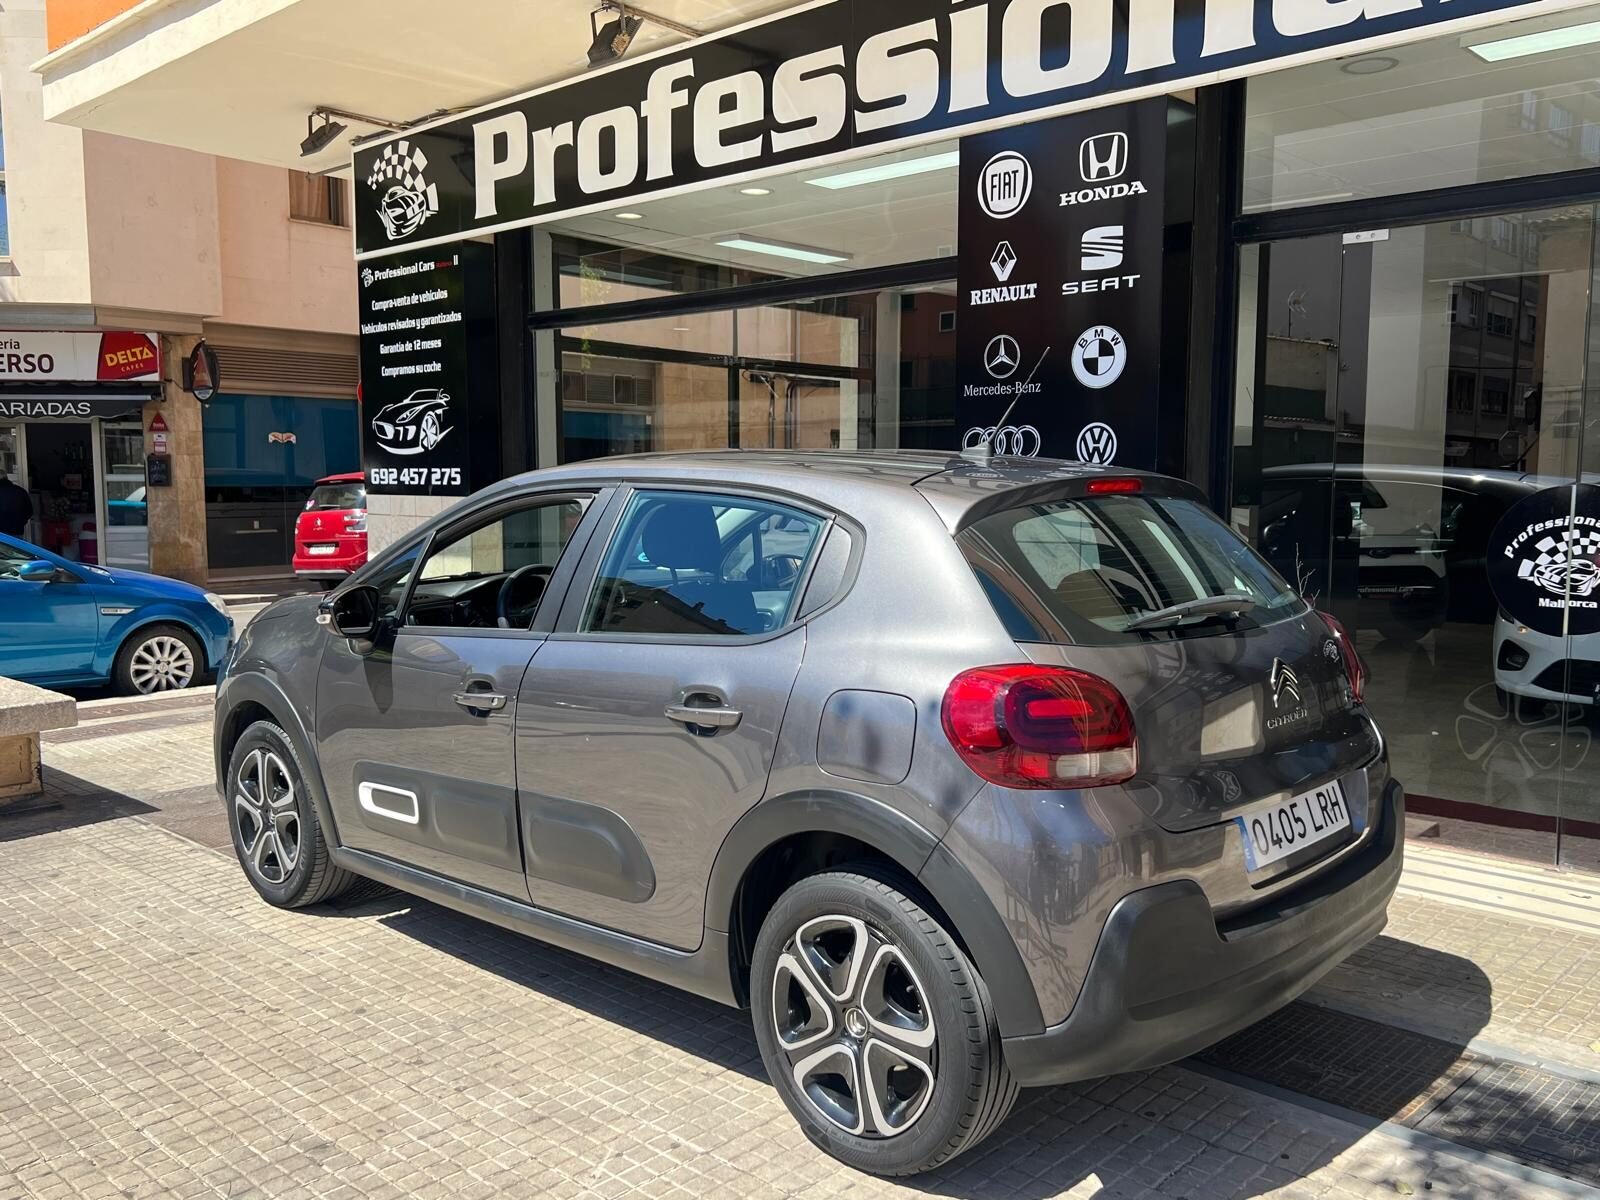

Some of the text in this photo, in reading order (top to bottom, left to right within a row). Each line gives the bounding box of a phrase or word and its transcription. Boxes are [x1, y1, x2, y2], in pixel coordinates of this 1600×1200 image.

[472, 0, 1455, 219] Profession
[990, 169, 1019, 202] FIAT
[1059, 180, 1148, 207] HONDA
[374, 262, 418, 281] Professional
[419, 261, 435, 272] Cars
[970, 283, 1038, 306] RENAULT
[1061, 274, 1141, 296] SEAT
[371, 295, 411, 311] Compra-venta
[411, 293, 419, 304] de
[388, 317, 415, 331] revisados
[415, 318, 421, 330] y
[421, 311, 462, 329] garantizados
[405, 340, 413, 352] de
[413, 339, 421, 350] 12
[421, 338, 442, 350] meses
[1078, 328, 1121, 348] BMW
[105, 346, 154, 367] DELTA
[381, 360, 442, 378] Compramos su coche
[963, 381, 1041, 397] Mercedes-Benz
[0, 402, 91, 415] ARIADAS
[370, 467, 462, 485] 692 457 275
[1538, 597, 1598, 609] Mallorca
[1252, 785, 1345, 856] 0405 LRH
